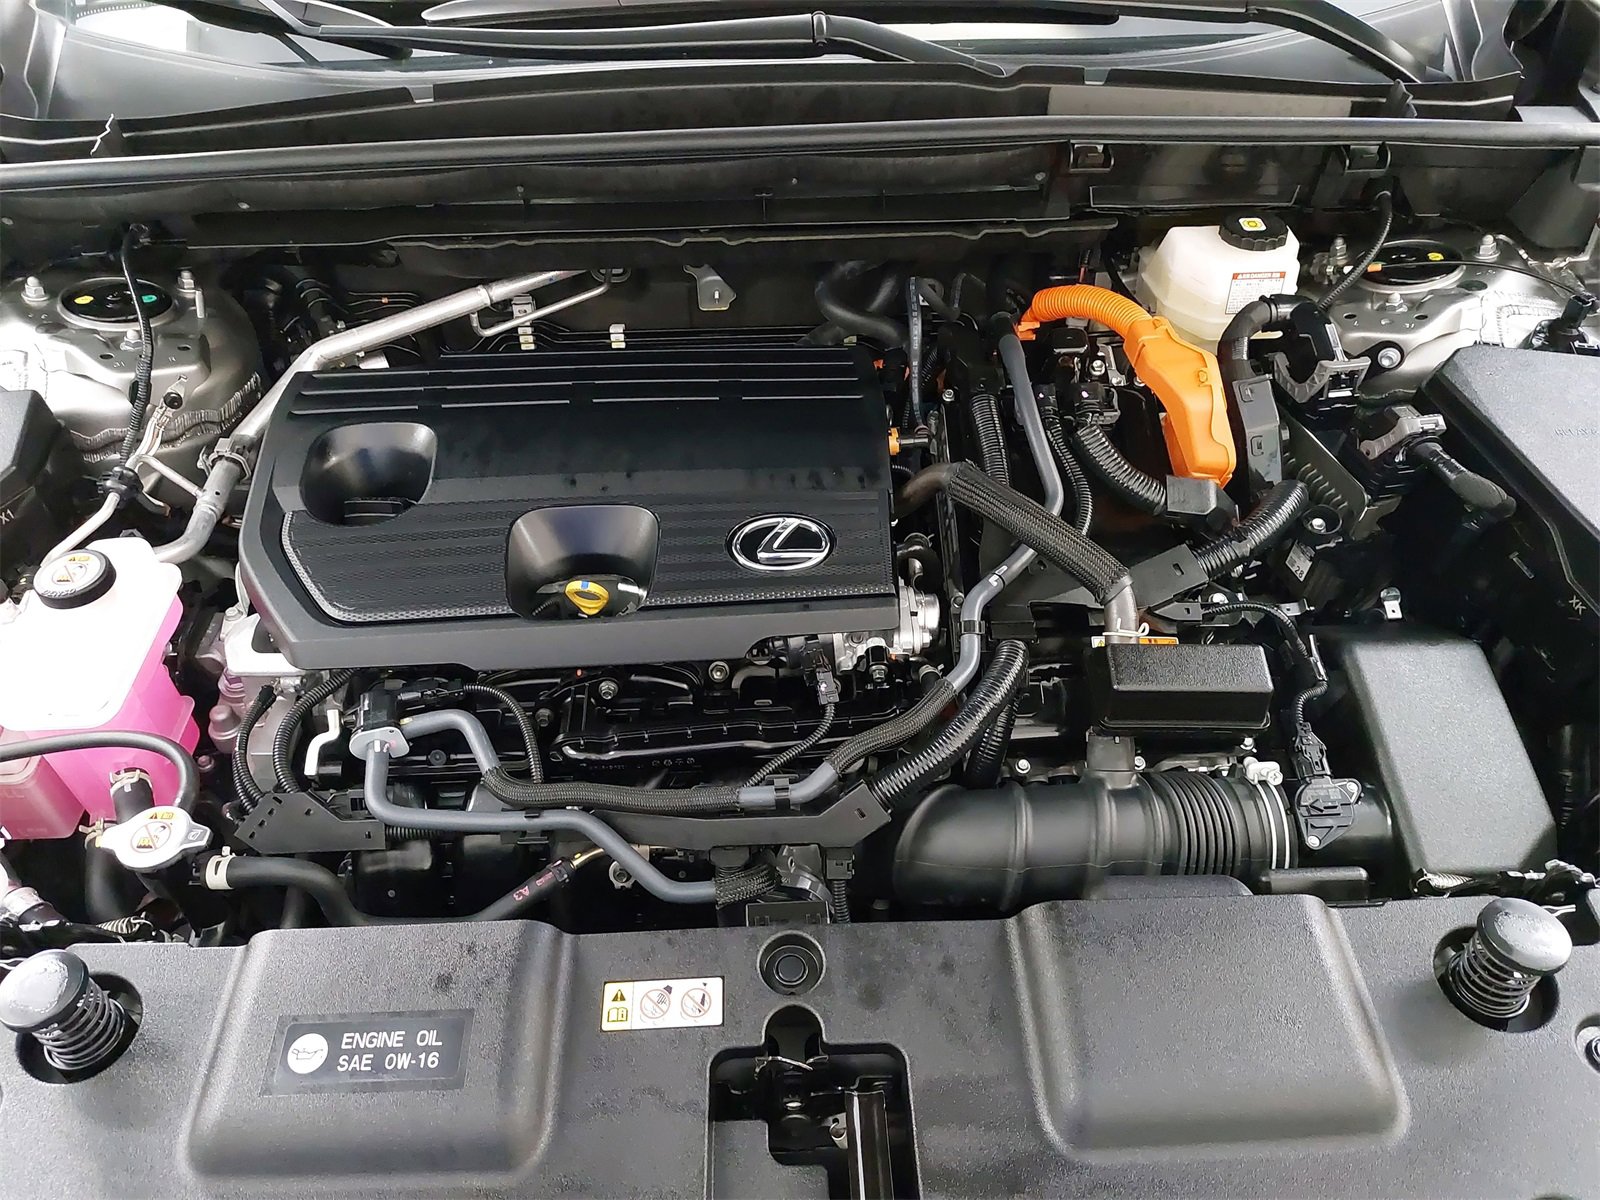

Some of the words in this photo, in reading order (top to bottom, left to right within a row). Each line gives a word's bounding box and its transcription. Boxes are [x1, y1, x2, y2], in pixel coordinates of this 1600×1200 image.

[1294, 565, 1305, 579] 28
[1568, 594, 1587, 615] XK
[340, 1031, 405, 1049] ENGINE
[416, 1029, 443, 1047] OIL
[336, 1053, 374, 1072] SAE
[384, 1052, 440, 1070] 0W-16
